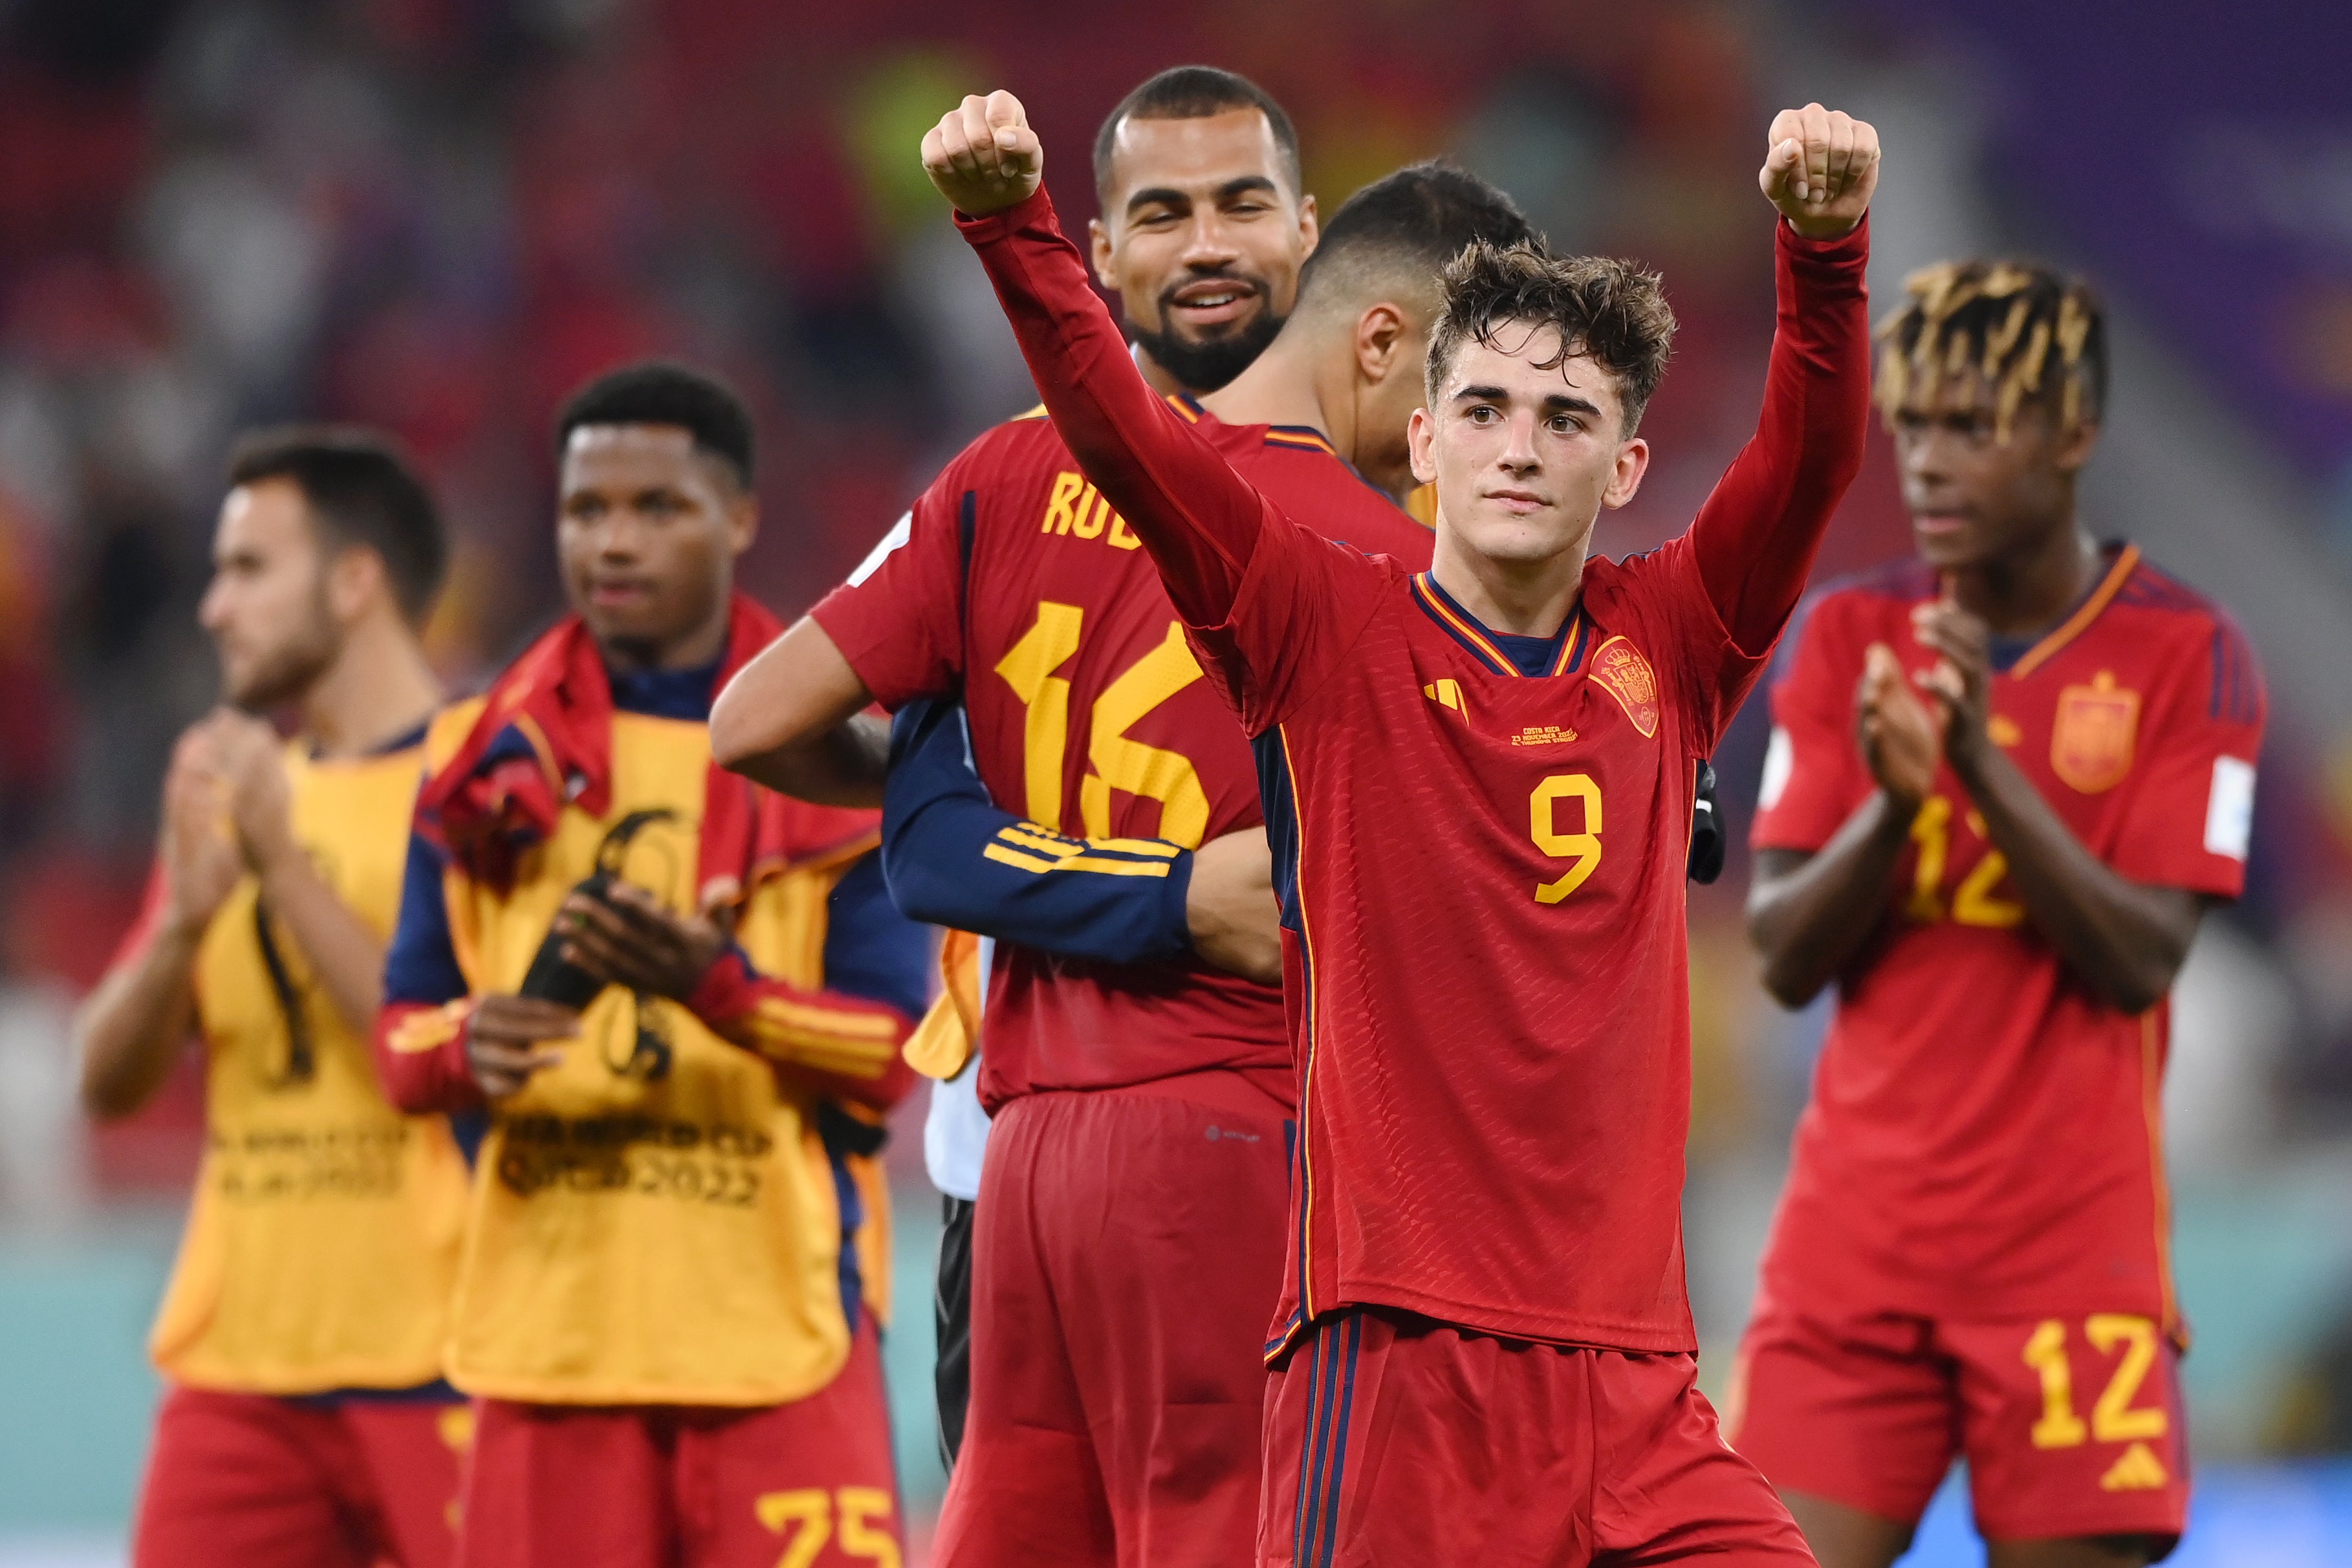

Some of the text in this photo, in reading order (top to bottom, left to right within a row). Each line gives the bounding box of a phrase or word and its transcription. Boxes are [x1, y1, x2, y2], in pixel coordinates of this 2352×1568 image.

[995, 600, 1210, 851] 16
[1530, 774, 1602, 904] 9
[2022, 1313, 2168, 1449] 12
